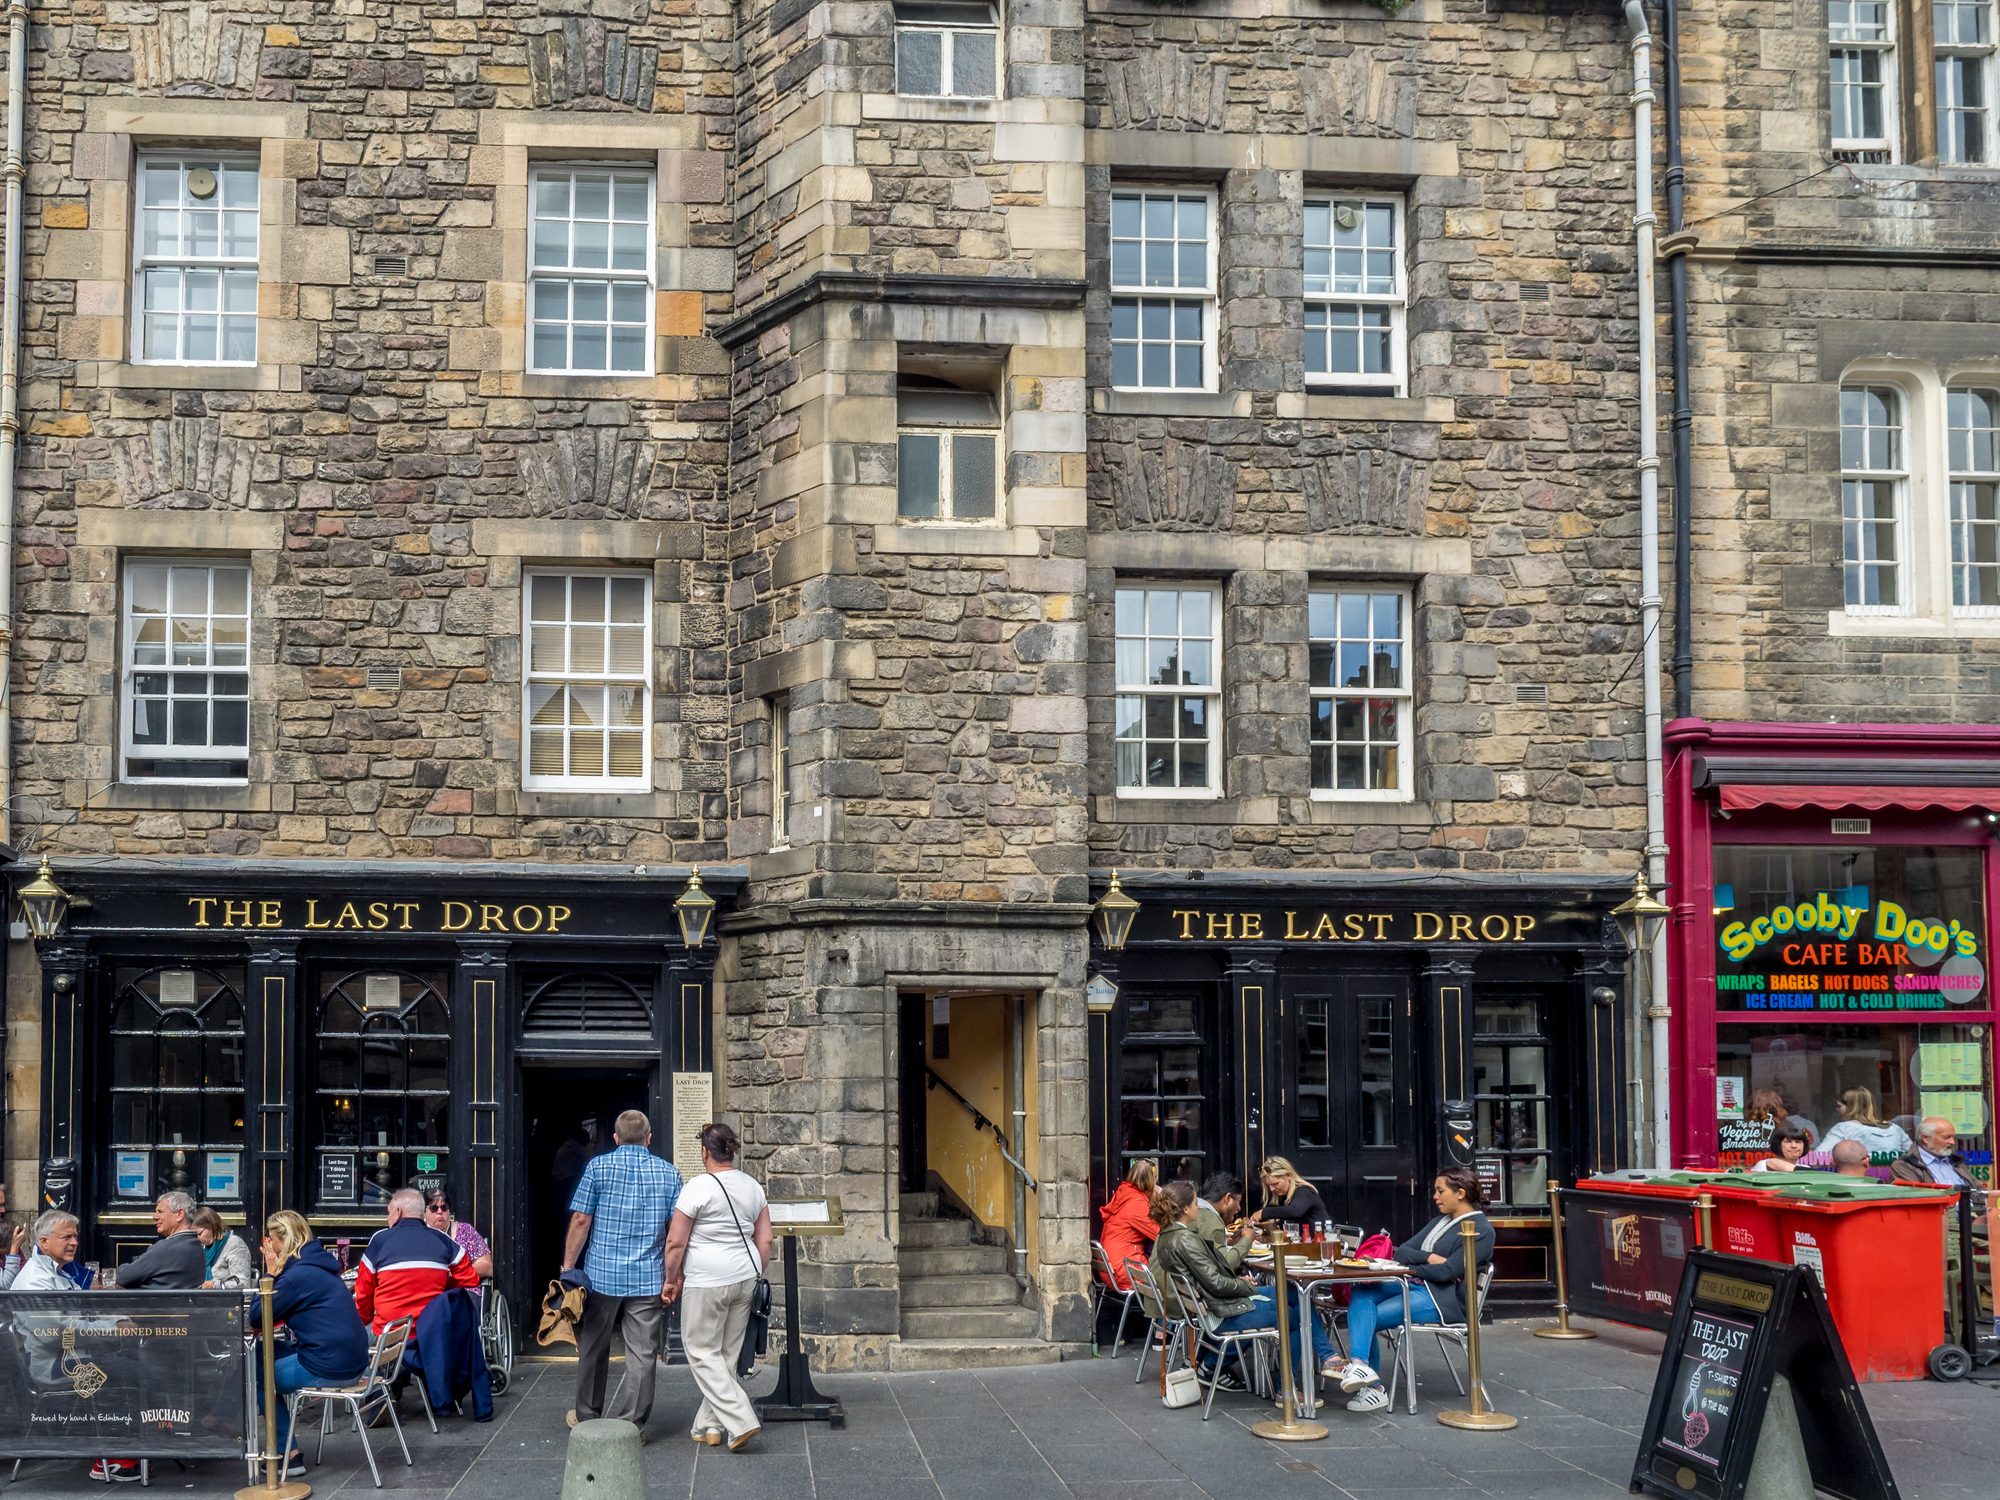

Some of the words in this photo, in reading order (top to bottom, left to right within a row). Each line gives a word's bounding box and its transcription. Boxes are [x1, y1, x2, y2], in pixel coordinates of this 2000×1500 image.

[188, 897, 283, 928] THE
[304, 899, 420, 930] LAST
[440, 901, 571, 932] DROP
[1172, 909, 1264, 939] THE
[1283, 911, 1394, 940] LAST
[1413, 911, 1536, 941] DROP
[1720, 892, 1861, 961] Scooby
[1874, 899, 1977, 959] Doo's
[1782, 943, 1848, 965] CAFE
[1858, 943, 1911, 965] BAR
[1716, 974, 1765, 990] WRAPS
[1770, 974, 1819, 990] BAGELS
[1824, 974, 1850, 990] HOT
[1852, 974, 1889, 990] DOGS
[1894, 974, 1982, 990] SANDWICHES
[1745, 993, 1767, 1009] ICE
[1769, 993, 1814, 1009] CREAM
[1819, 993, 1846, 1009] HOT
[1848, 995, 1858, 1009] &
[1860, 993, 1894, 1009] COLD
[1896, 993, 1945, 1009] DRINKS
[1719, 1125, 1762, 1139] Veggie
[1722, 1139, 1770, 1150] Smoothies
[1718, 1151, 1743, 1167] HOT
[1745, 1151, 1777, 1167] DO
[1728, 1226, 1754, 1245] Biffa
[1795, 1231, 1817, 1246] Biffa
[1645, 1290, 1672, 1305] DEUCHARS
[1701, 1280, 1719, 1292] THE
[1719, 1283, 1742, 1298] LAST
[1742, 1289, 1769, 1304] DROP
[33, 1328, 59, 1337] CASK
[79, 1327, 152, 1337] CONDITIONED
[155, 1327, 188, 1336] BEERS
[1692, 1319, 1715, 1341] THE
[1715, 1326, 1749, 1350] LAST
[1701, 1342, 1729, 1363] DROP
[31, 1413, 57, 1422] Brewed
[58, 1413, 68, 1424] by
[69, 1413, 88, 1422] hand
[98, 1413, 133, 1425] Edinburgh
[140, 1408, 191, 1424] DEUCHARS
